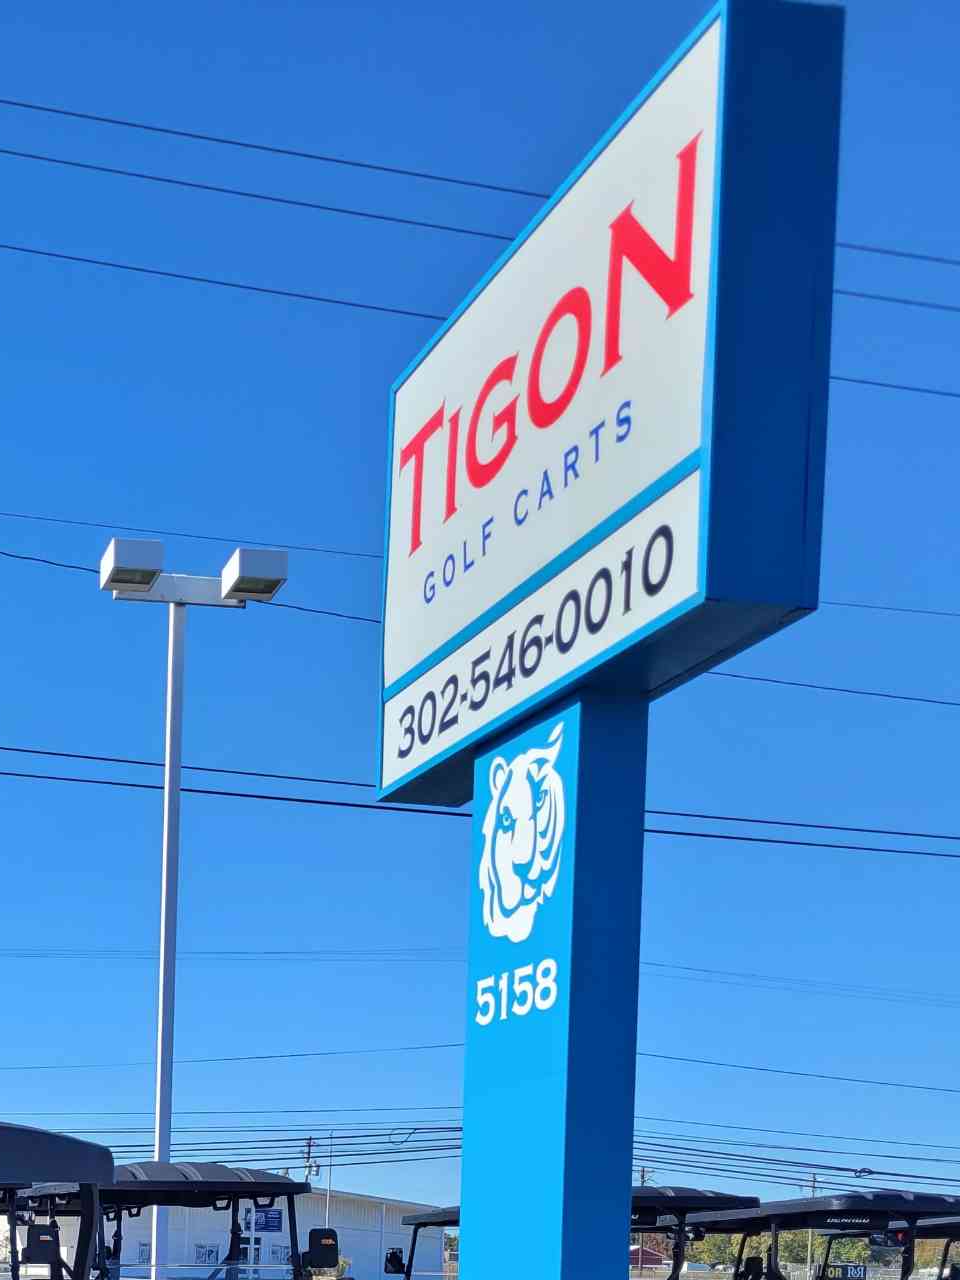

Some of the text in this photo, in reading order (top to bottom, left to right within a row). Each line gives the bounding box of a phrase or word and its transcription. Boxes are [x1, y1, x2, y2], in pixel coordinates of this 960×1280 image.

[399, 130, 703, 558] TIGON
[423, 400, 632, 604] GOLF CARTS
[396, 524, 675, 760] 302-546-0010
[474, 958, 558, 1027] 5158
